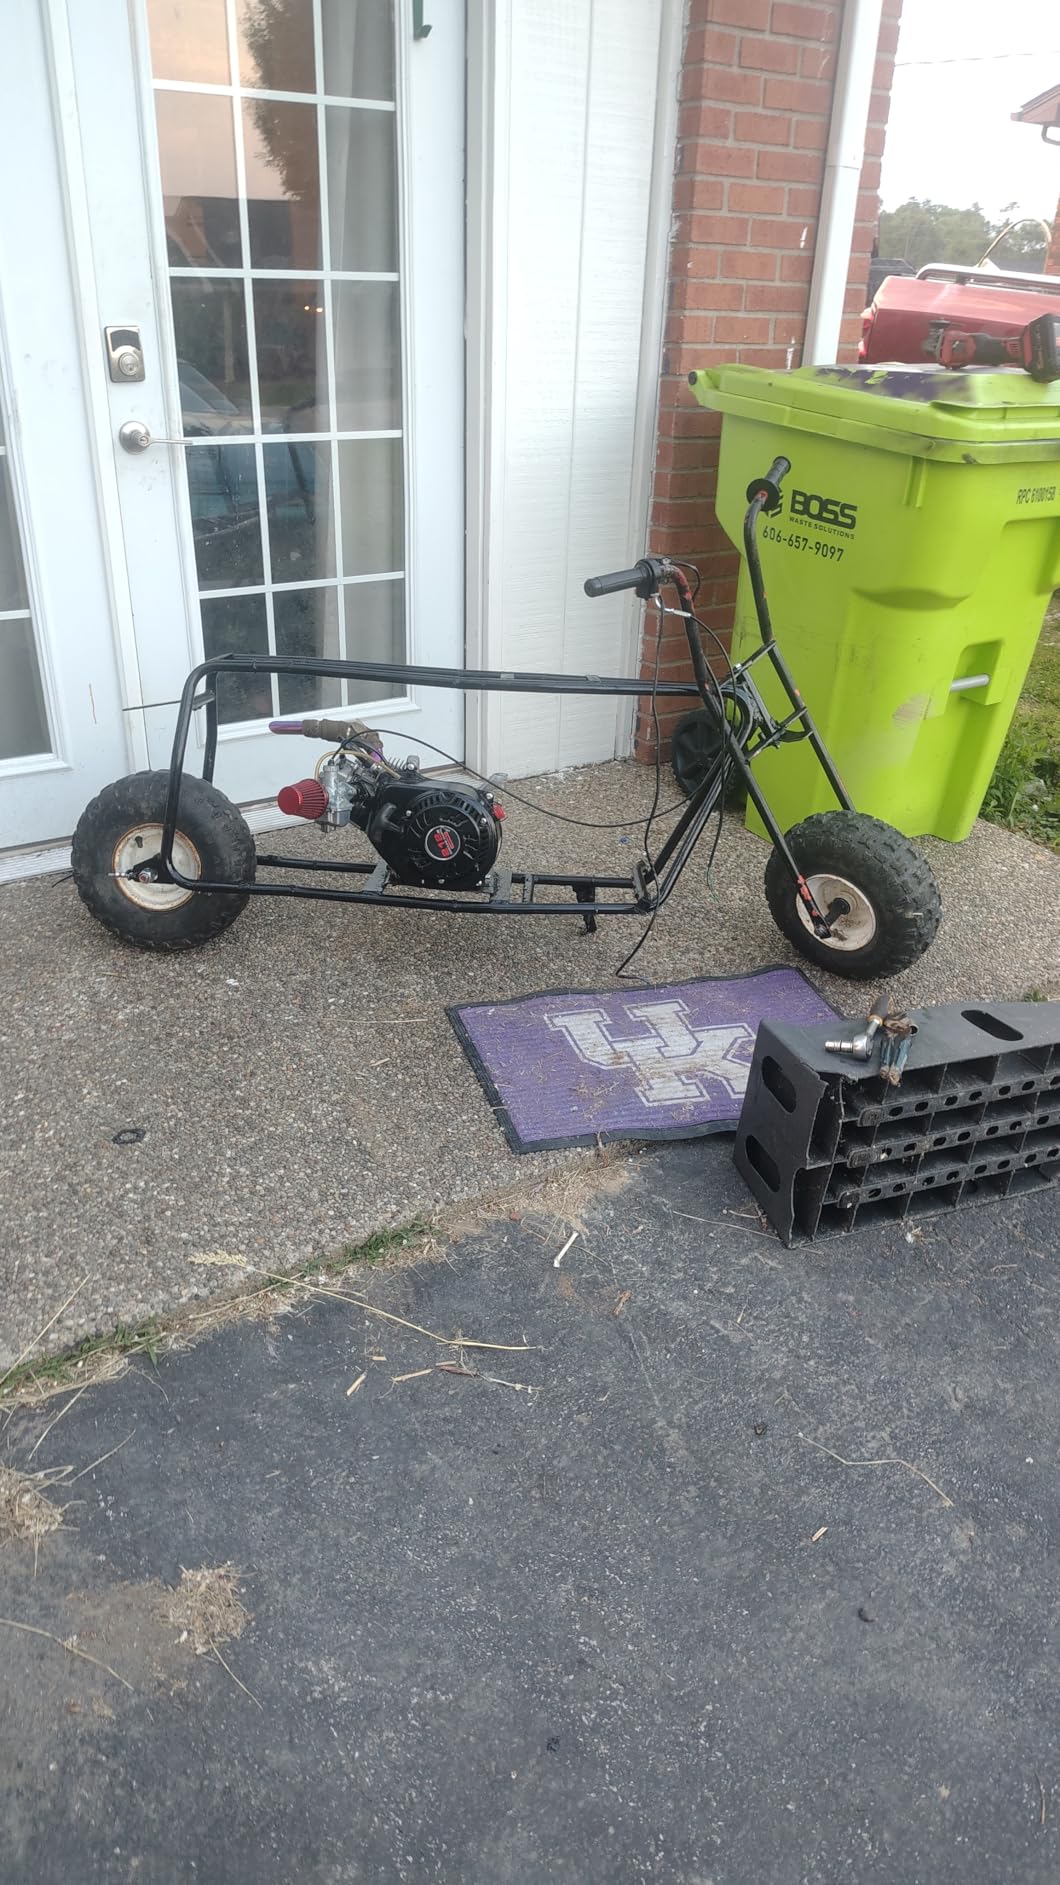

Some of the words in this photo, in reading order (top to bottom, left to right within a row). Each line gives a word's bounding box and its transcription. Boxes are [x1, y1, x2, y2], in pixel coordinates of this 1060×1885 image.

[790, 489, 858, 530] BOSS
[1016, 488, 1031, 504] RPC
[762, 525, 844, 562] 606-657-9097
[789, 516, 812, 528] WASTE
[813, 523, 855, 540] SOLUTIONS
[544, 999, 757, 1106] UK
